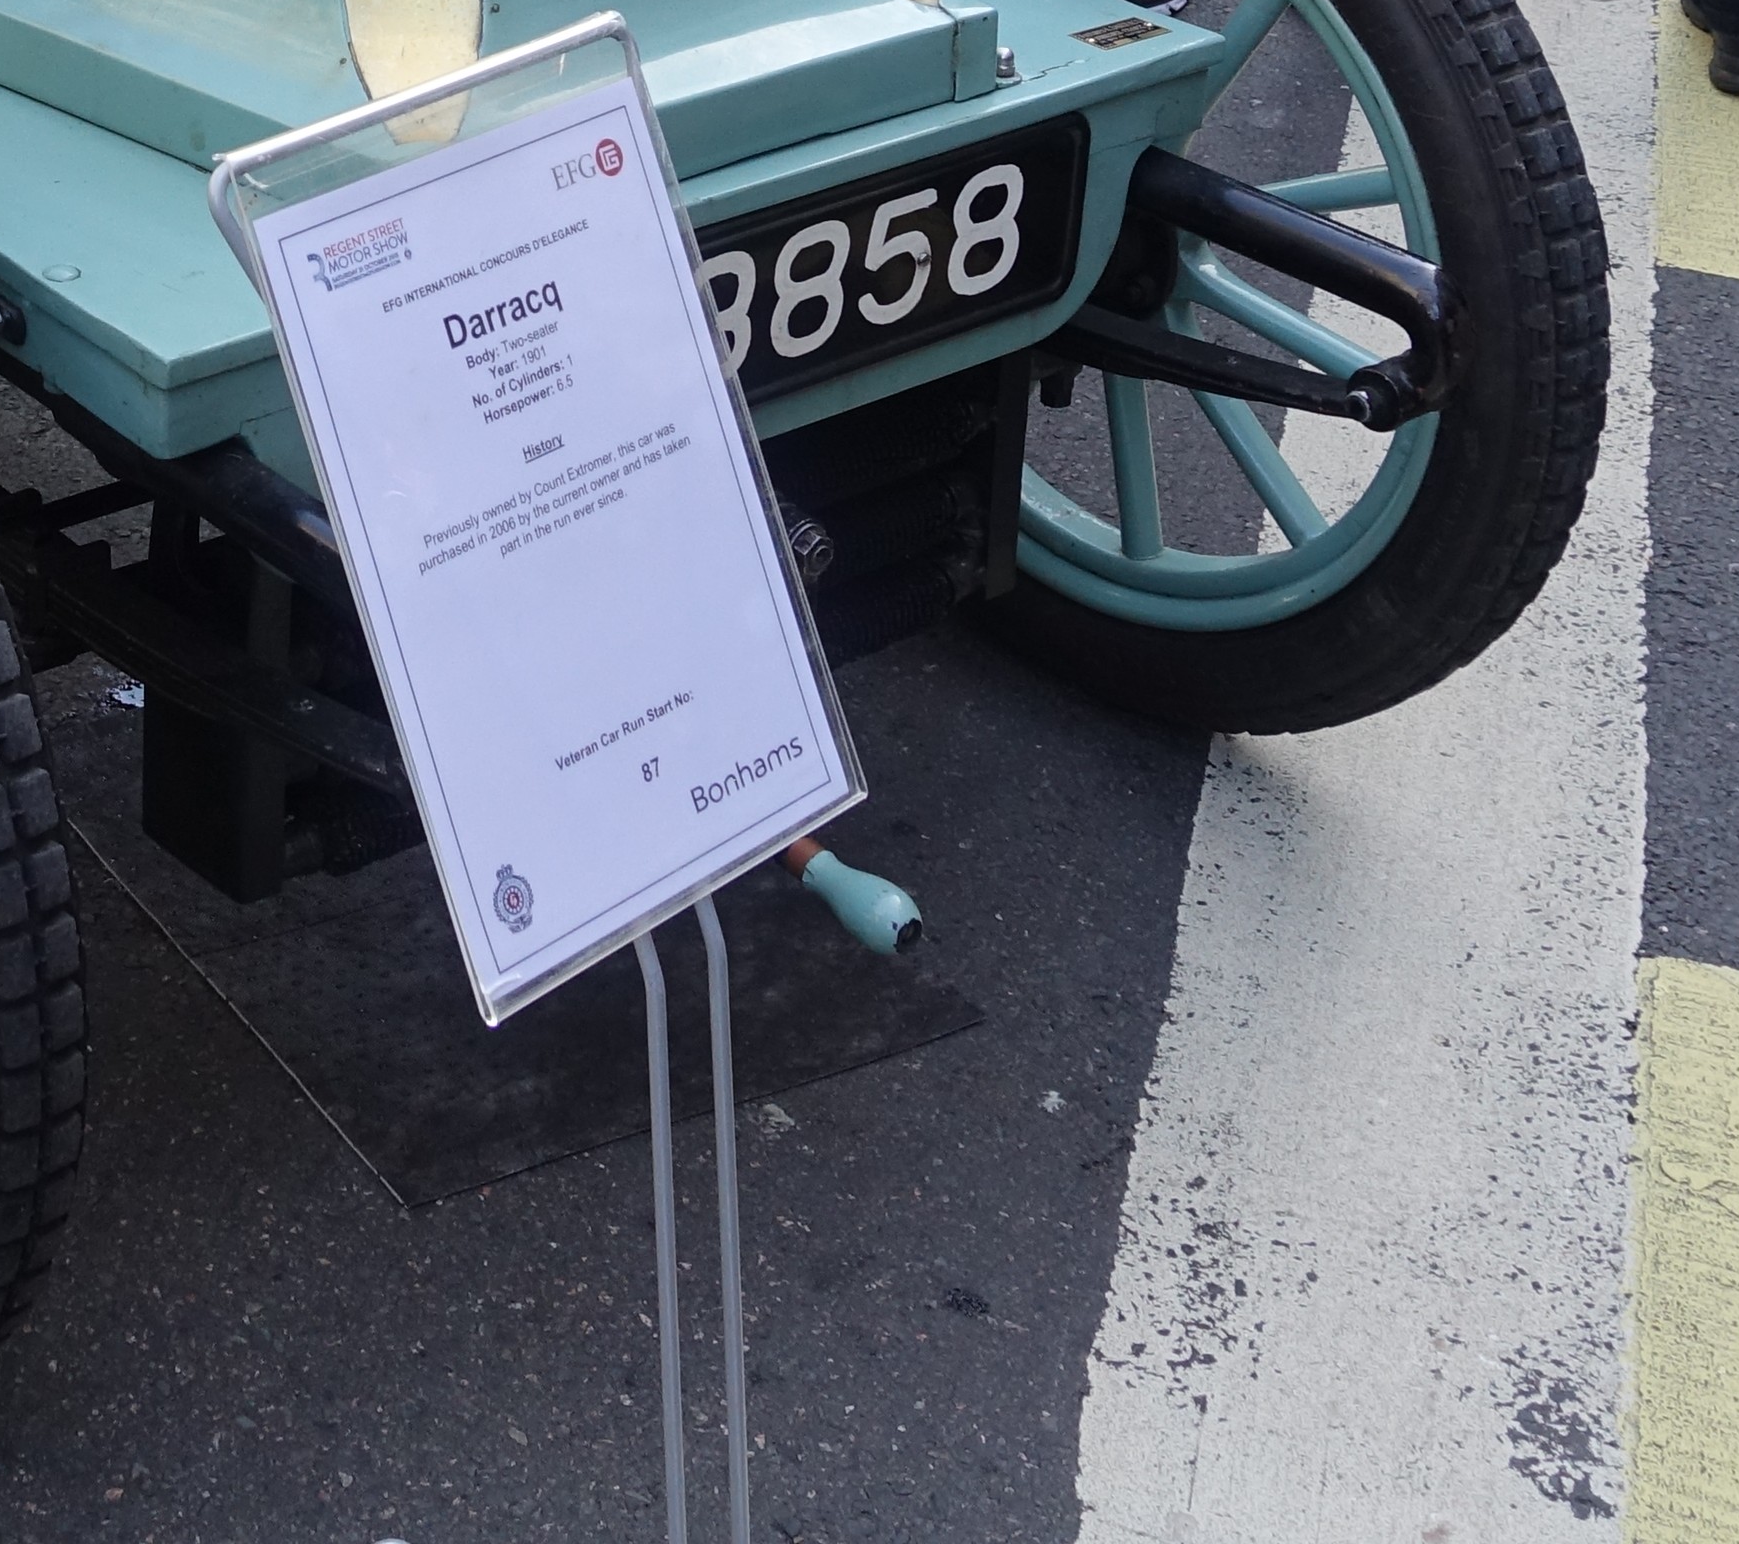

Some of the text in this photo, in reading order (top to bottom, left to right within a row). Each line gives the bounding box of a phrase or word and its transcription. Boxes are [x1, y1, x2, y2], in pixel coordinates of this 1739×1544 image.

[550, 154, 597, 191] EFG
[323, 218, 404, 259] REGENT STREET
[328, 246, 373, 274] MOTOR
[373, 232, 408, 256] SHOW
[382, 296, 403, 313] EFG
[404, 265, 479, 304] INTERNATIONAL
[479, 243, 532, 272] CONCOURS
[532, 218, 589, 251] D'ELEGANCE
[443, 280, 564, 350] Darracq
[465, 320, 559, 370] Body: Two-seater
[488, 344, 547, 380] Year: 1901
[472, 353, 573, 408] No. of Cylinders: 1
[483, 373, 573, 424] Horsepower: 6.5
[522, 433, 564, 462] History
[418, 436, 691, 576] purchased in 2006 by the current owner and has taken
[423, 423, 676, 549] Previously owned by Count Extromer, this car was
[500, 487, 627, 559] part in the run ever since.
[555, 690, 694, 771] Veteran Car Run Start No:
[641, 756, 660, 783] 87
[689, 734, 804, 814] Bonhams
